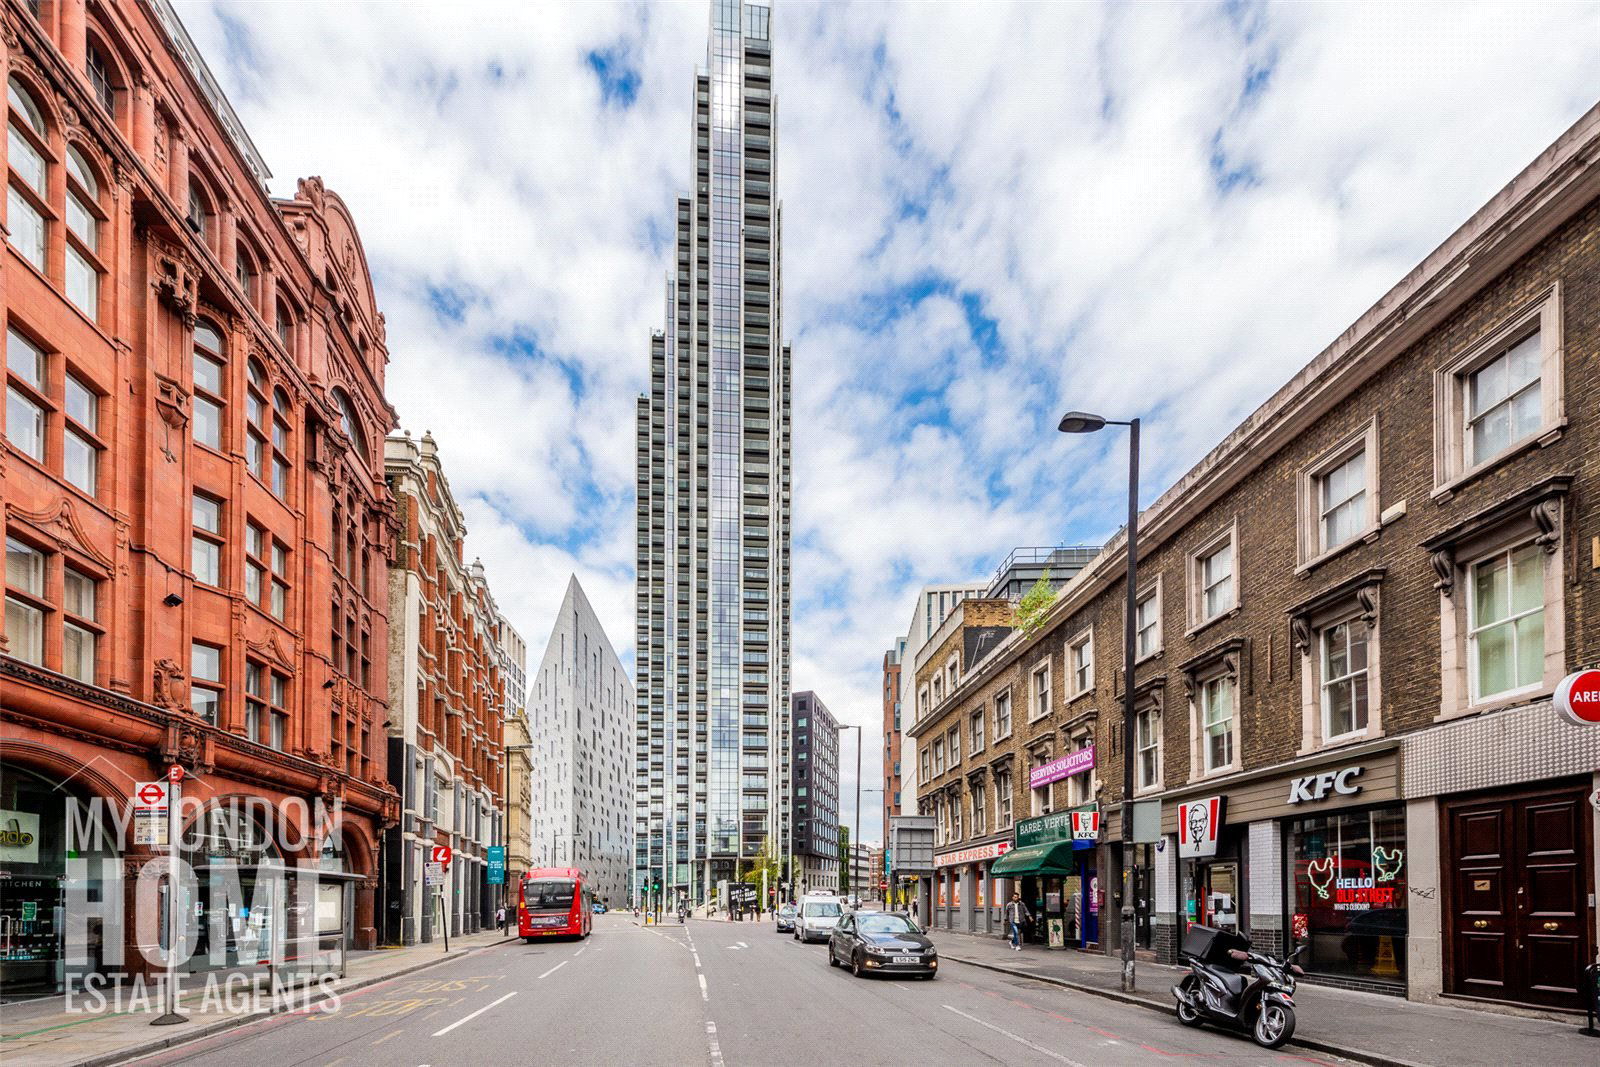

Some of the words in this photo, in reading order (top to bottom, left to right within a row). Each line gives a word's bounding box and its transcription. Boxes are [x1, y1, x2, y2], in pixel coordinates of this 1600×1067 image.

[1056, 749, 1092, 772] SOLICITORS
[171, 767, 178, 779] E
[1287, 766, 1362, 804] KFC
[941, 853, 956, 865] STAR
[958, 846, 994, 862] EXPRESS
[1336, 877, 1373, 889] HELLO
[1336, 889, 1355, 902] OLD
